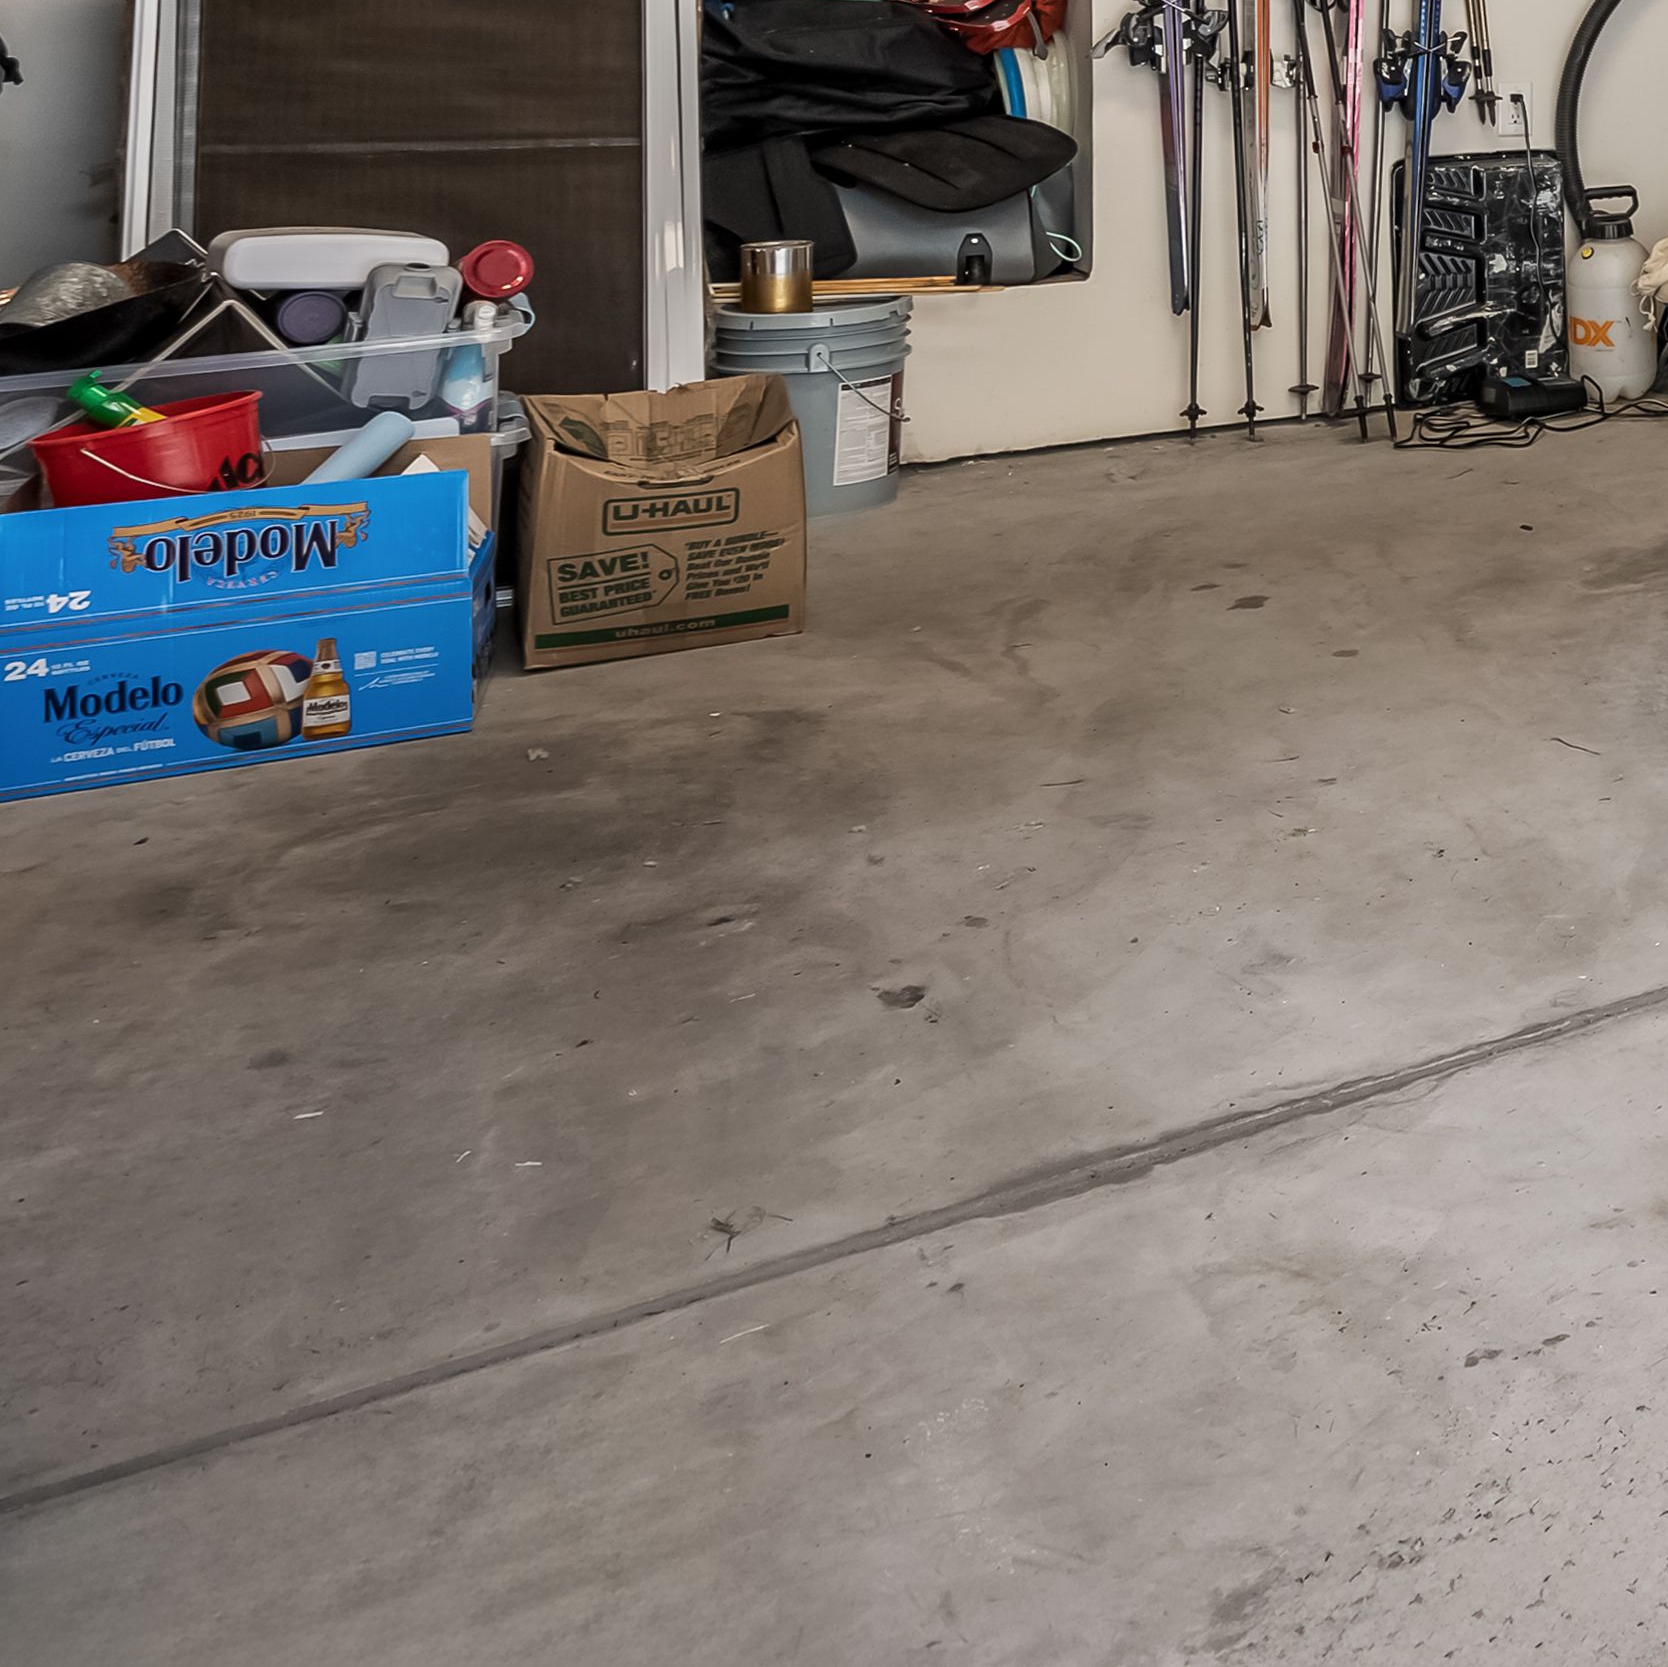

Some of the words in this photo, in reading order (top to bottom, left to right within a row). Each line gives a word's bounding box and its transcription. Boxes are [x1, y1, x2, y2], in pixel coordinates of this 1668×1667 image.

[1569, 316, 1615, 348] DX
[613, 495, 731, 521] U-HAUL
[145, 520, 338, 583] Modelo
[687, 548, 718, 561] SAVE
[720, 545, 747, 557] EVEN
[714, 558, 733, 568] Our
[558, 552, 650, 583] SAVE!
[723, 566, 742, 576] and
[47, 590, 91, 613] 24
[559, 587, 598, 604] BEST
[604, 578, 650, 598] PRICE
[685, 589, 712, 601] FREE
[615, 618, 716, 638] uhaul.com
[4, 658, 49, 681] 24
[44, 676, 183, 723] Modelo
[56, 713, 167, 745] Especial
[63, 747, 114, 763] CERVEZA
[133, 737, 176, 752] FÚTBOL
